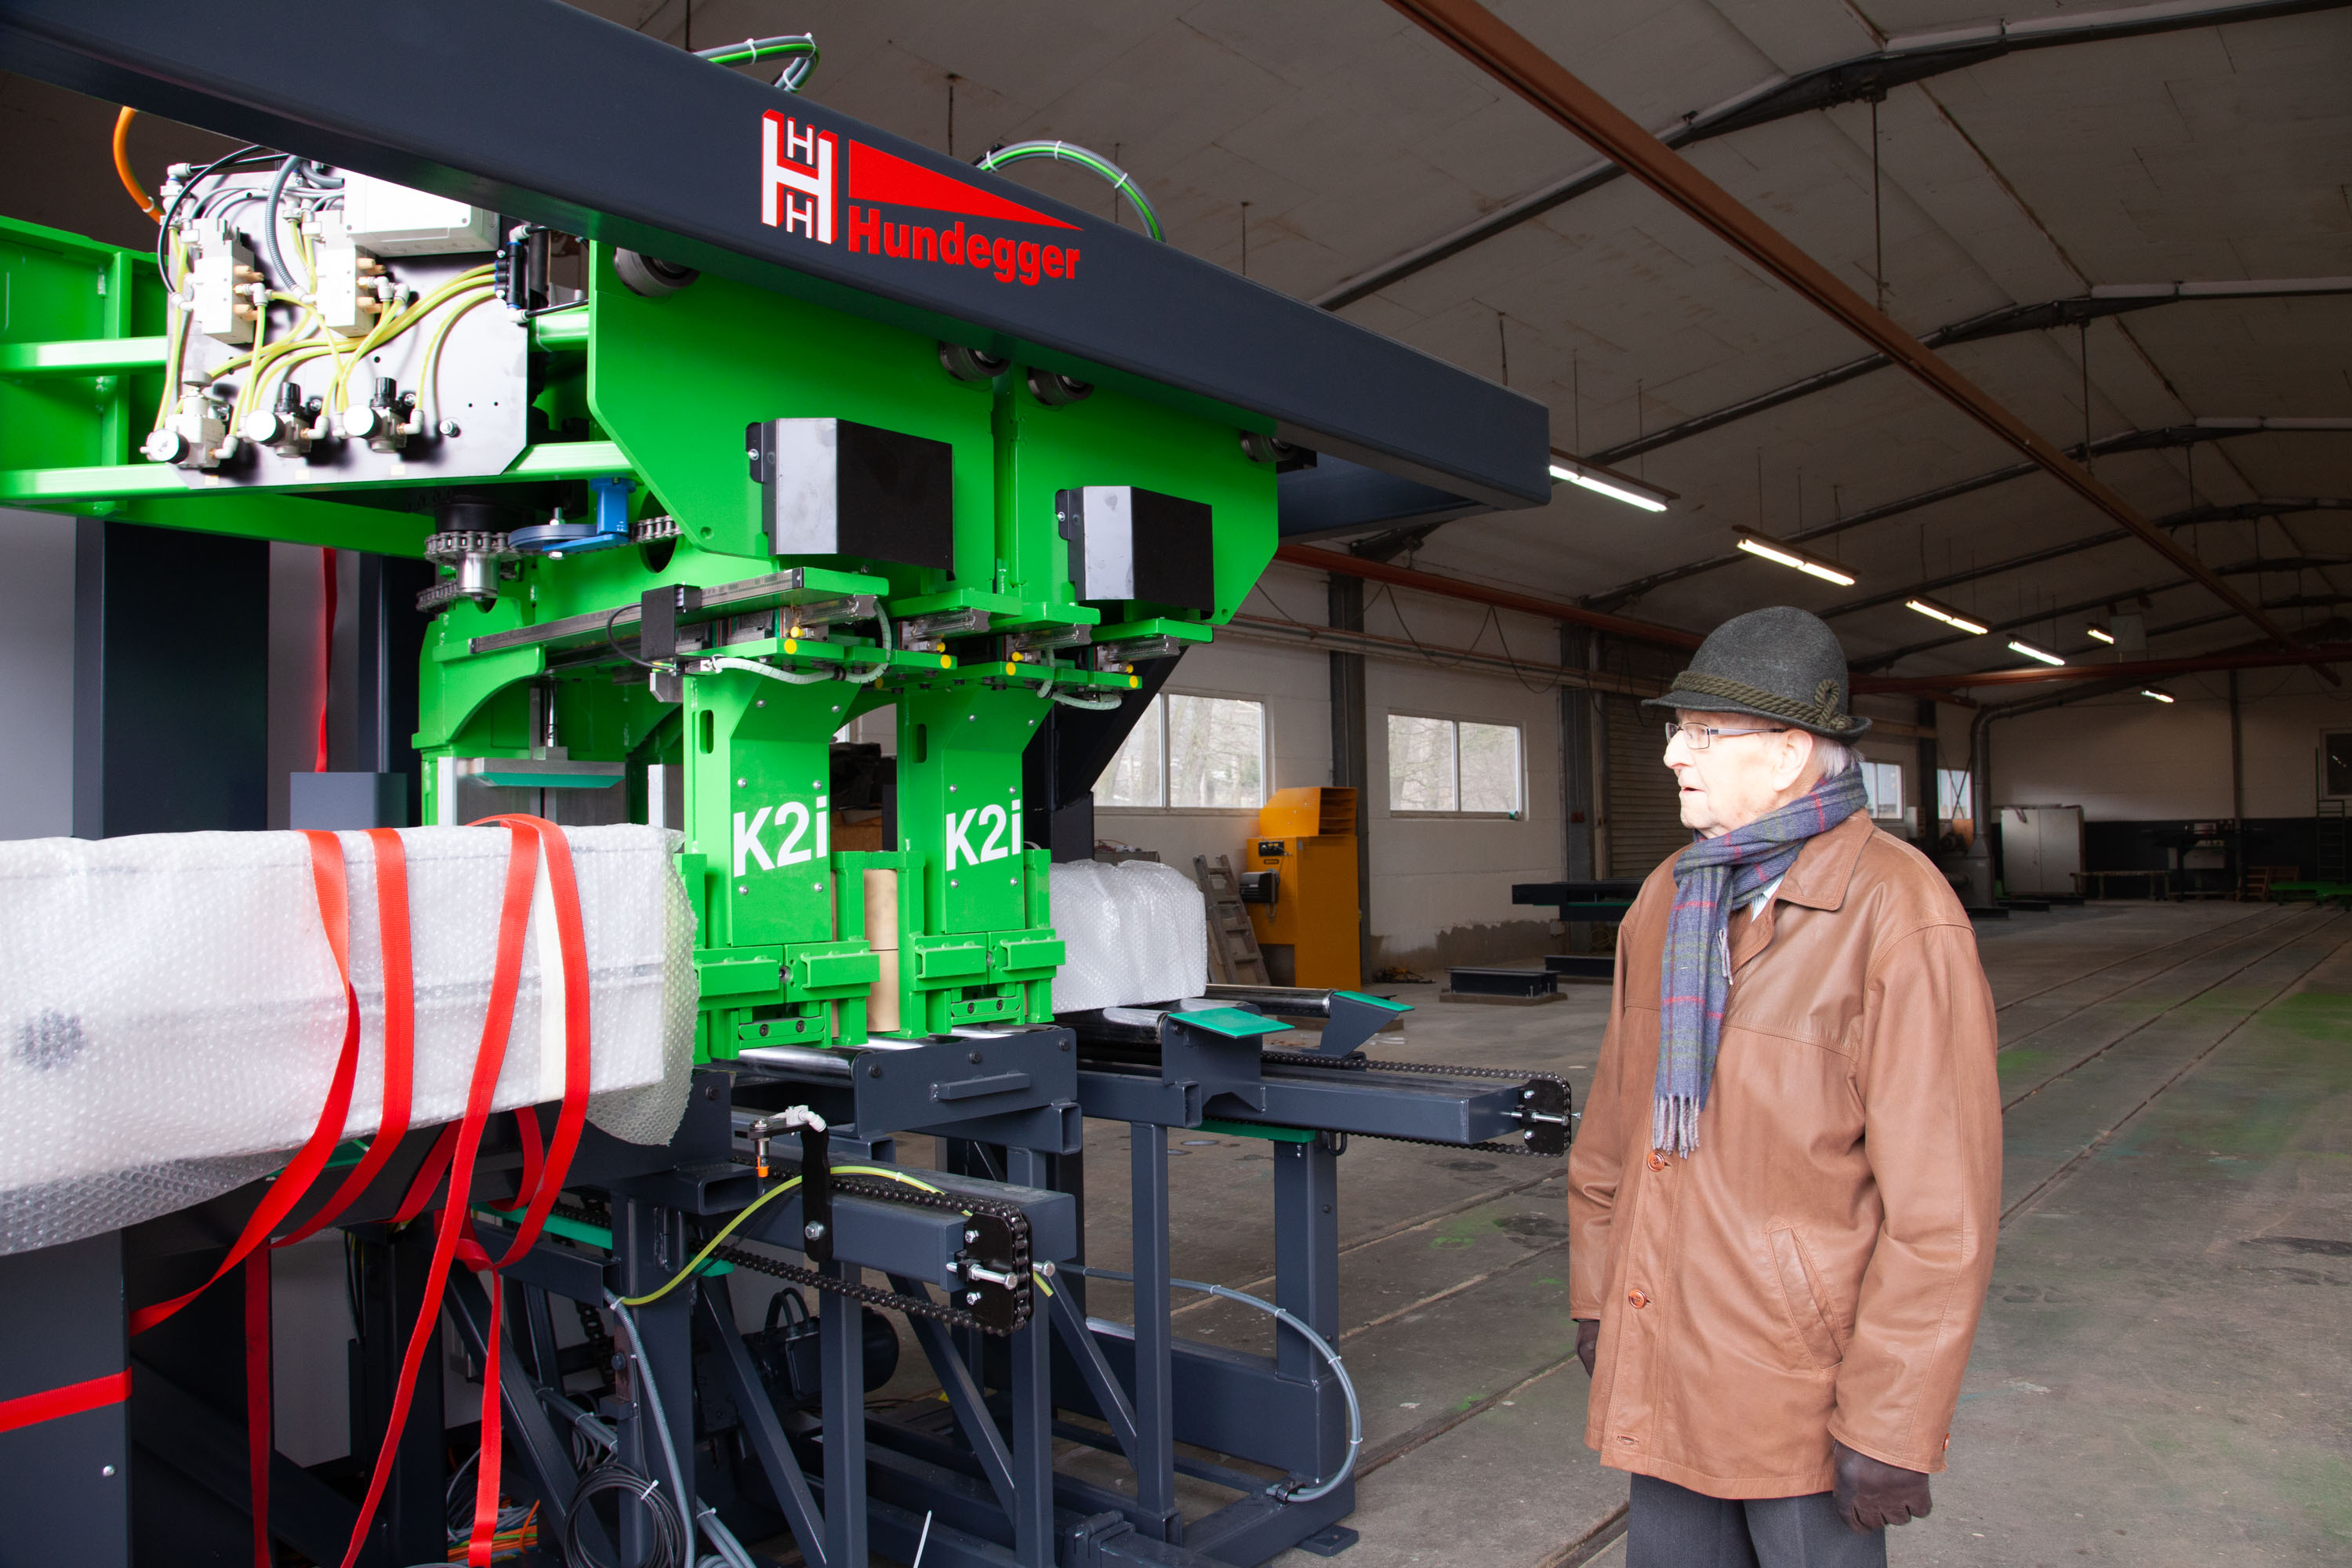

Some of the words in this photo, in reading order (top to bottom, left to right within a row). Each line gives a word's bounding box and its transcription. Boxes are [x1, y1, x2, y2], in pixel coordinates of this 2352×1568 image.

[848, 205, 1080, 286] Hundegger
[733, 795, 828, 878] K2i
[946, 799, 1021, 872] K2i
